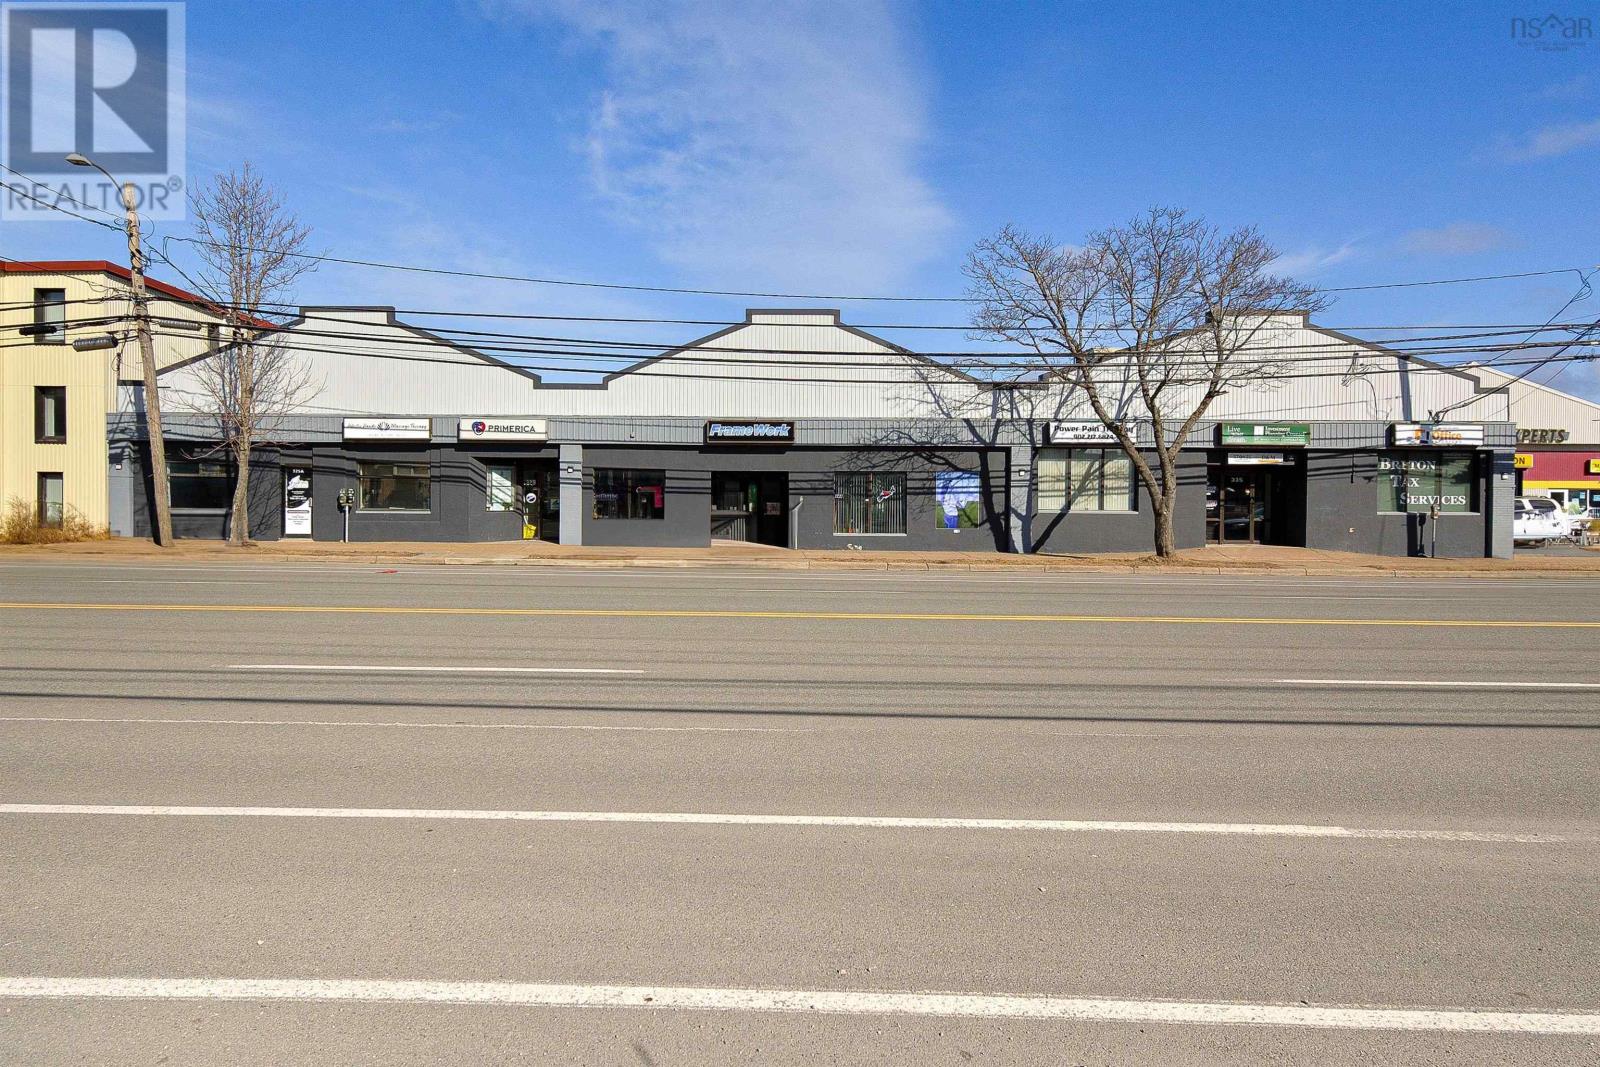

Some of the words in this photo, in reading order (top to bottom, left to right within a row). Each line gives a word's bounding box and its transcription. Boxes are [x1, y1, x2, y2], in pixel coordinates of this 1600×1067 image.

[487, 424, 536, 433] PRIMERICA
[1054, 425, 1079, 433] Power
[1082, 425, 1100, 433] Pain
[1227, 425, 1241, 433] Live
[1380, 458, 1436, 470] BRETON
[1391, 475, 1420, 488] TAX
[1400, 493, 1466, 505] SERVICES
